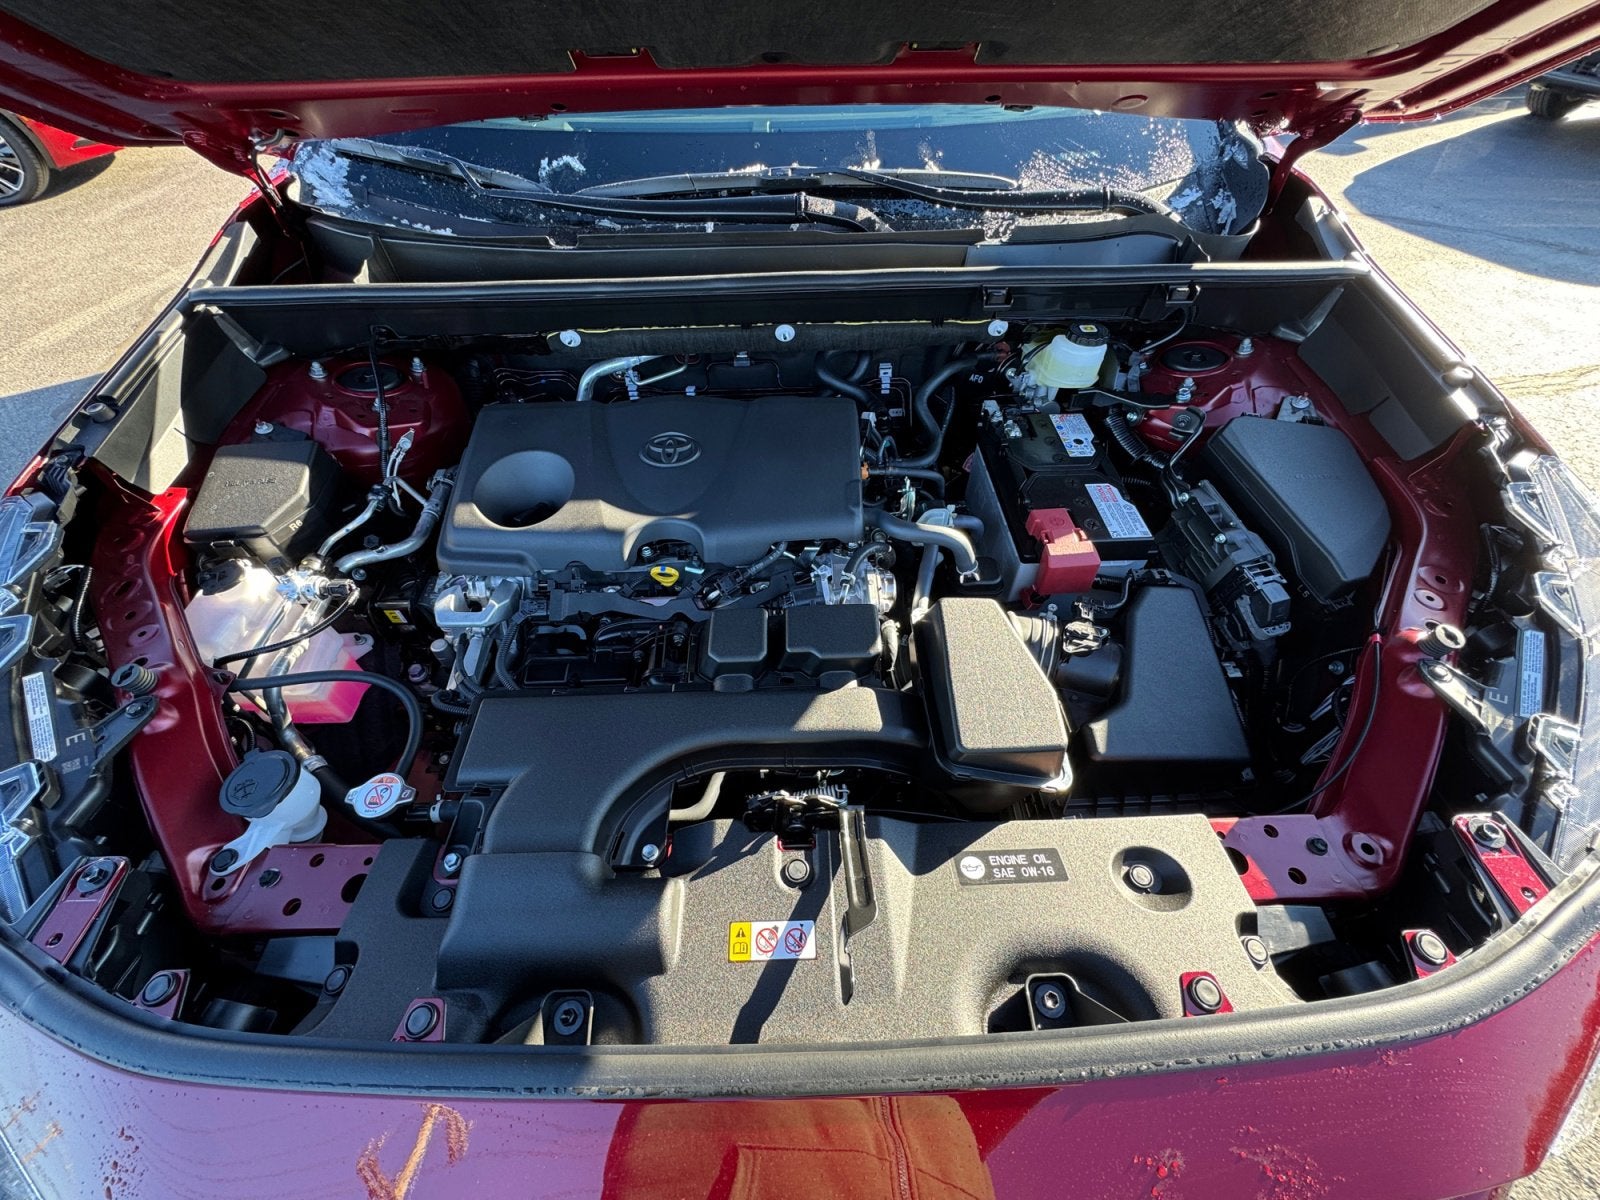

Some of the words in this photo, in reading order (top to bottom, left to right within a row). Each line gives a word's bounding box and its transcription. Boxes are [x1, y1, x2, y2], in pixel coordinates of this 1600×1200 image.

[988, 854, 1029, 866] ENGINE
[1033, 853, 1052, 864] OIL
[993, 867, 1017, 878] SAE
[1021, 865, 1056, 878] 0W-16
